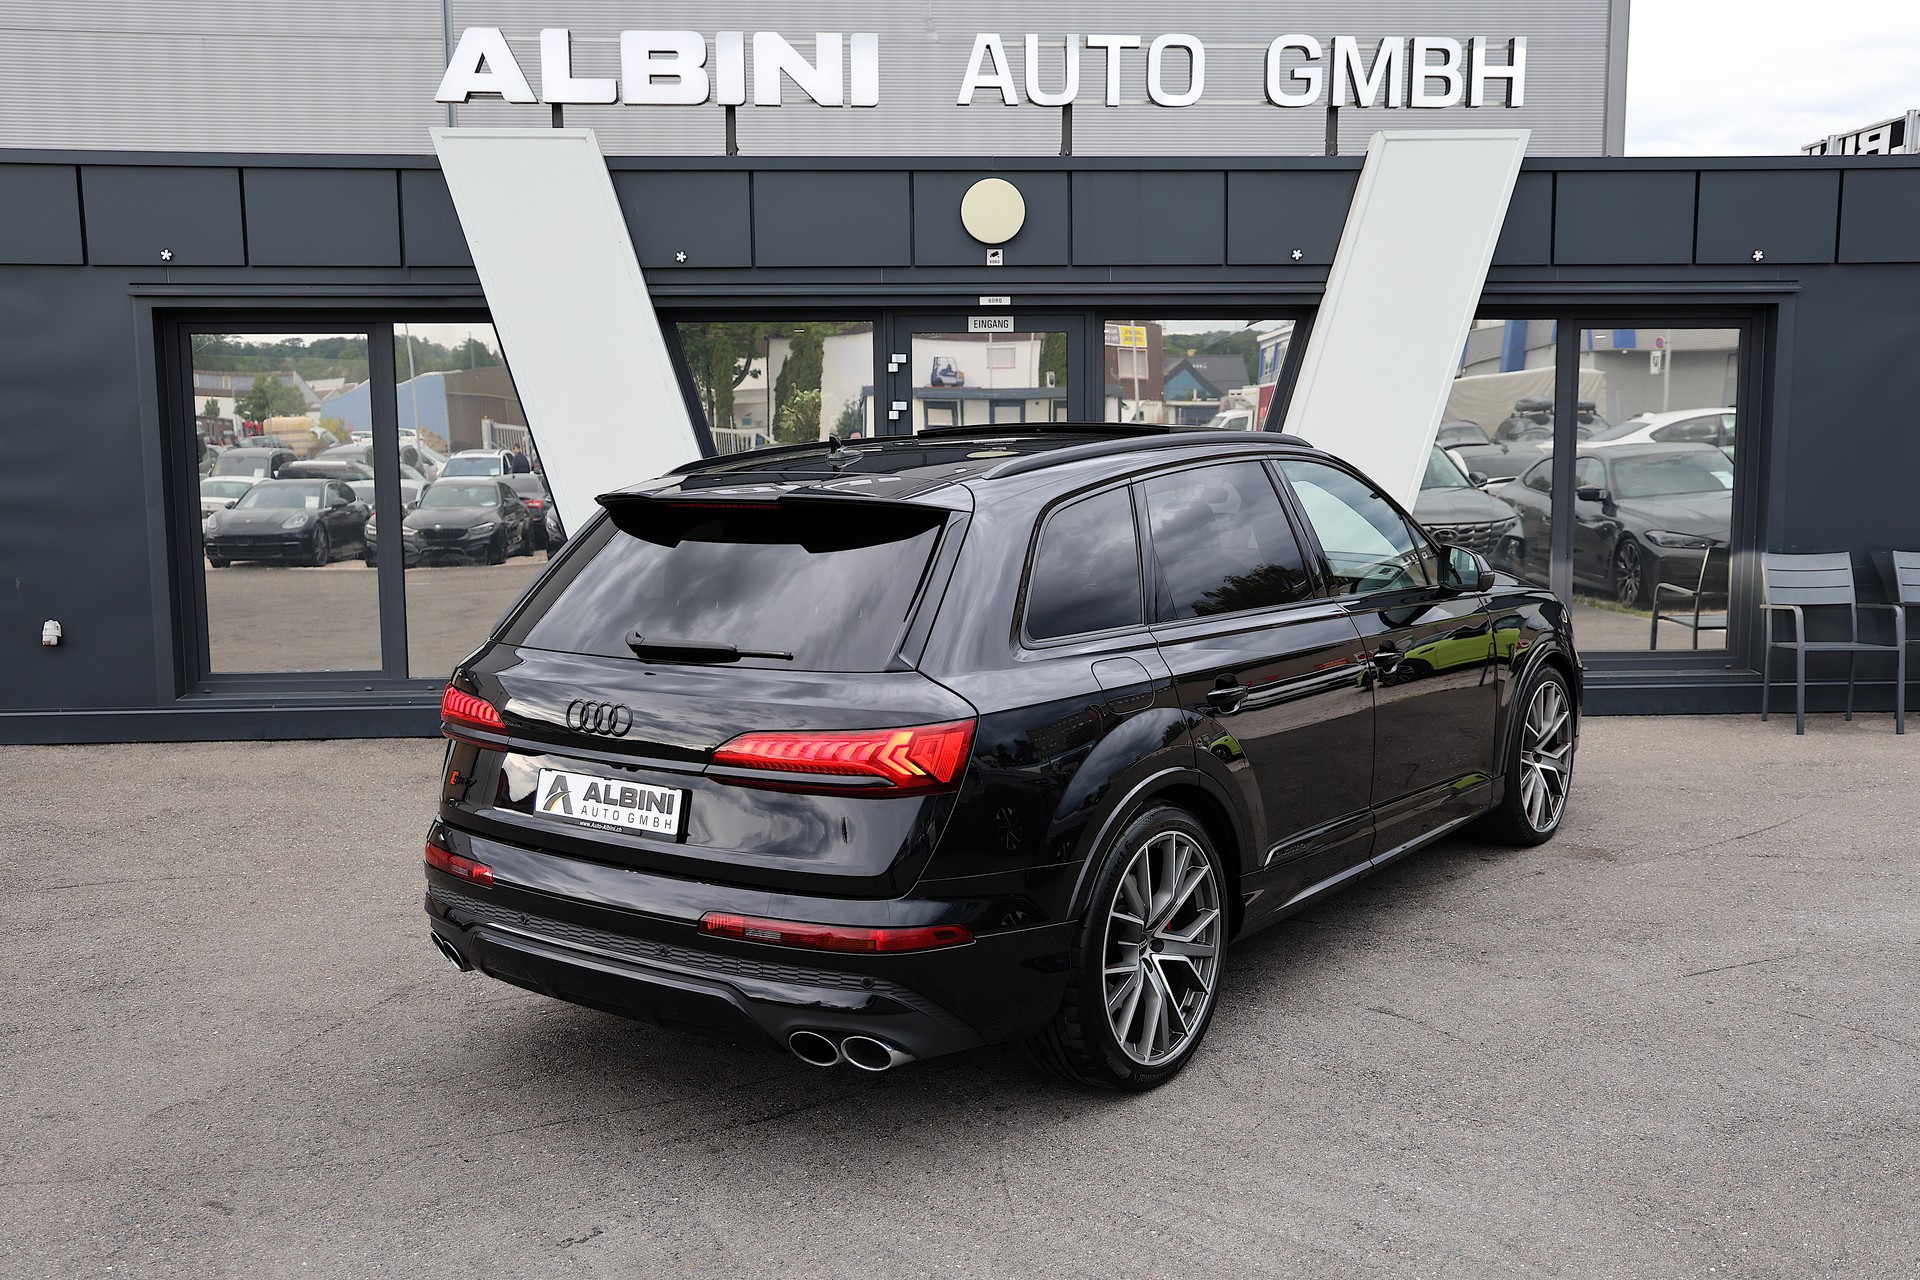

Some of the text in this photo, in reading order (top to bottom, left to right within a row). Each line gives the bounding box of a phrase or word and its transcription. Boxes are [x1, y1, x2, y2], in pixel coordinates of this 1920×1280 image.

[435, 27, 1528, 109] ALBINI AUTO GMBH
[973, 319, 1009, 329] EINGANG
[582, 781, 675, 815] ALBINI
[578, 820, 623, 833] www.Auto-Albini.ch
[580, 805, 672, 830] AUTO GMBH
